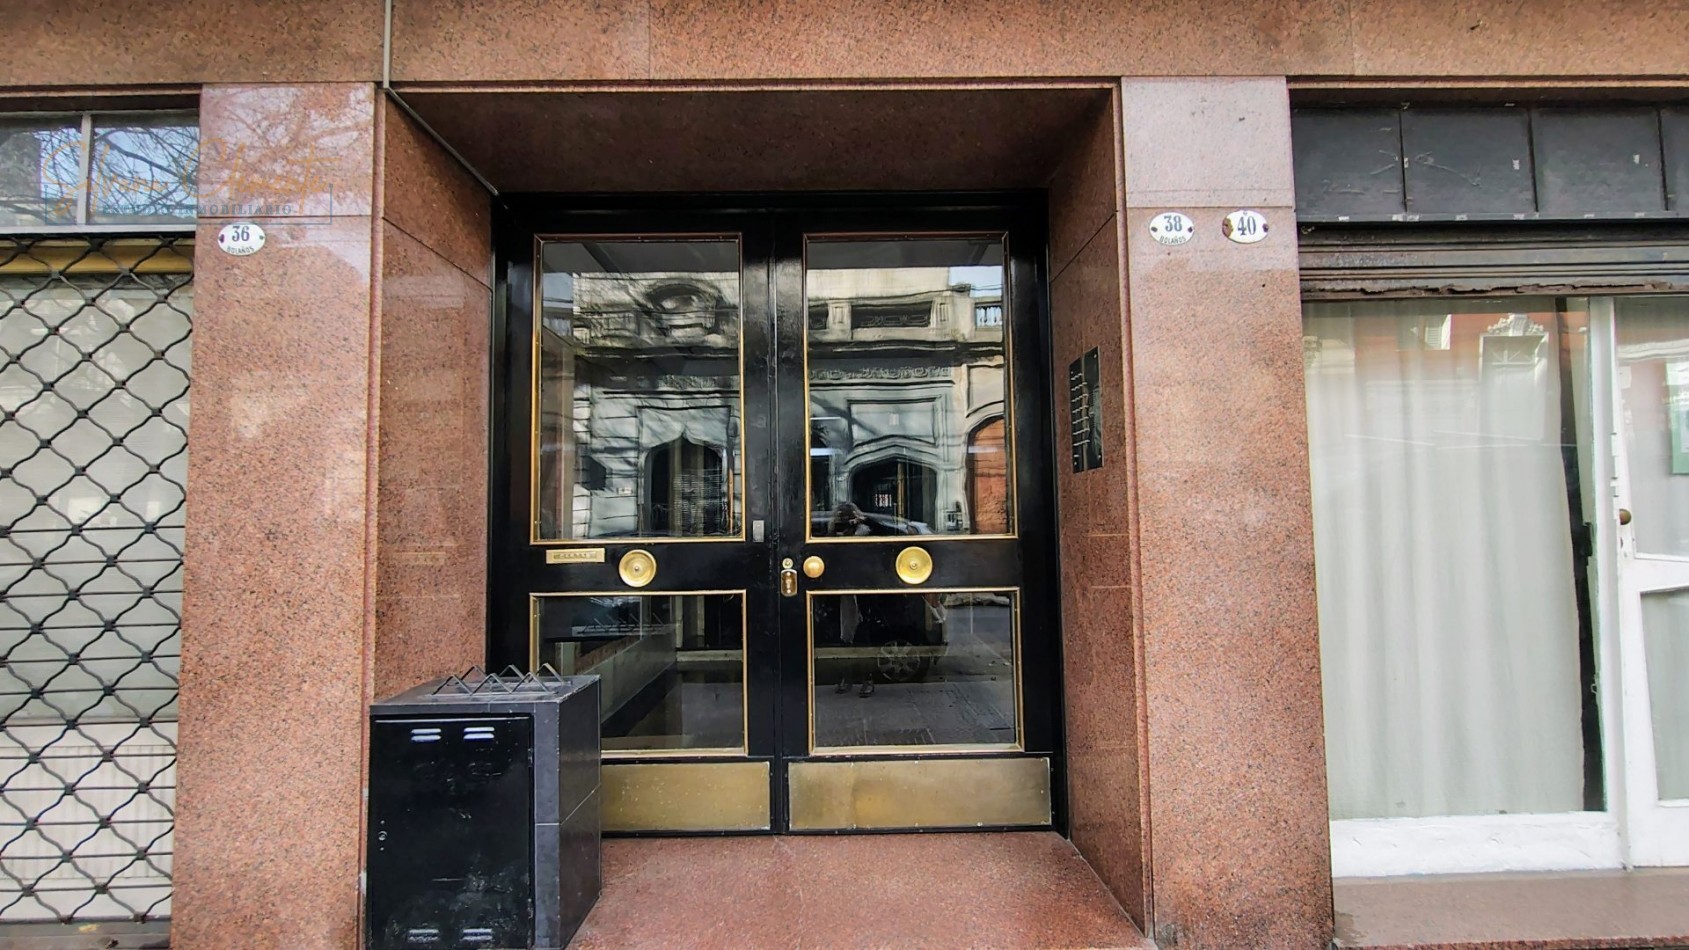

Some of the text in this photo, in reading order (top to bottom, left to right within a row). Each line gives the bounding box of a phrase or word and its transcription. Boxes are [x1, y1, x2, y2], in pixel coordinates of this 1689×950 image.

[1164, 215, 1183, 232] 38
[1237, 215, 1257, 236] 40
[232, 225, 250, 242] 36
